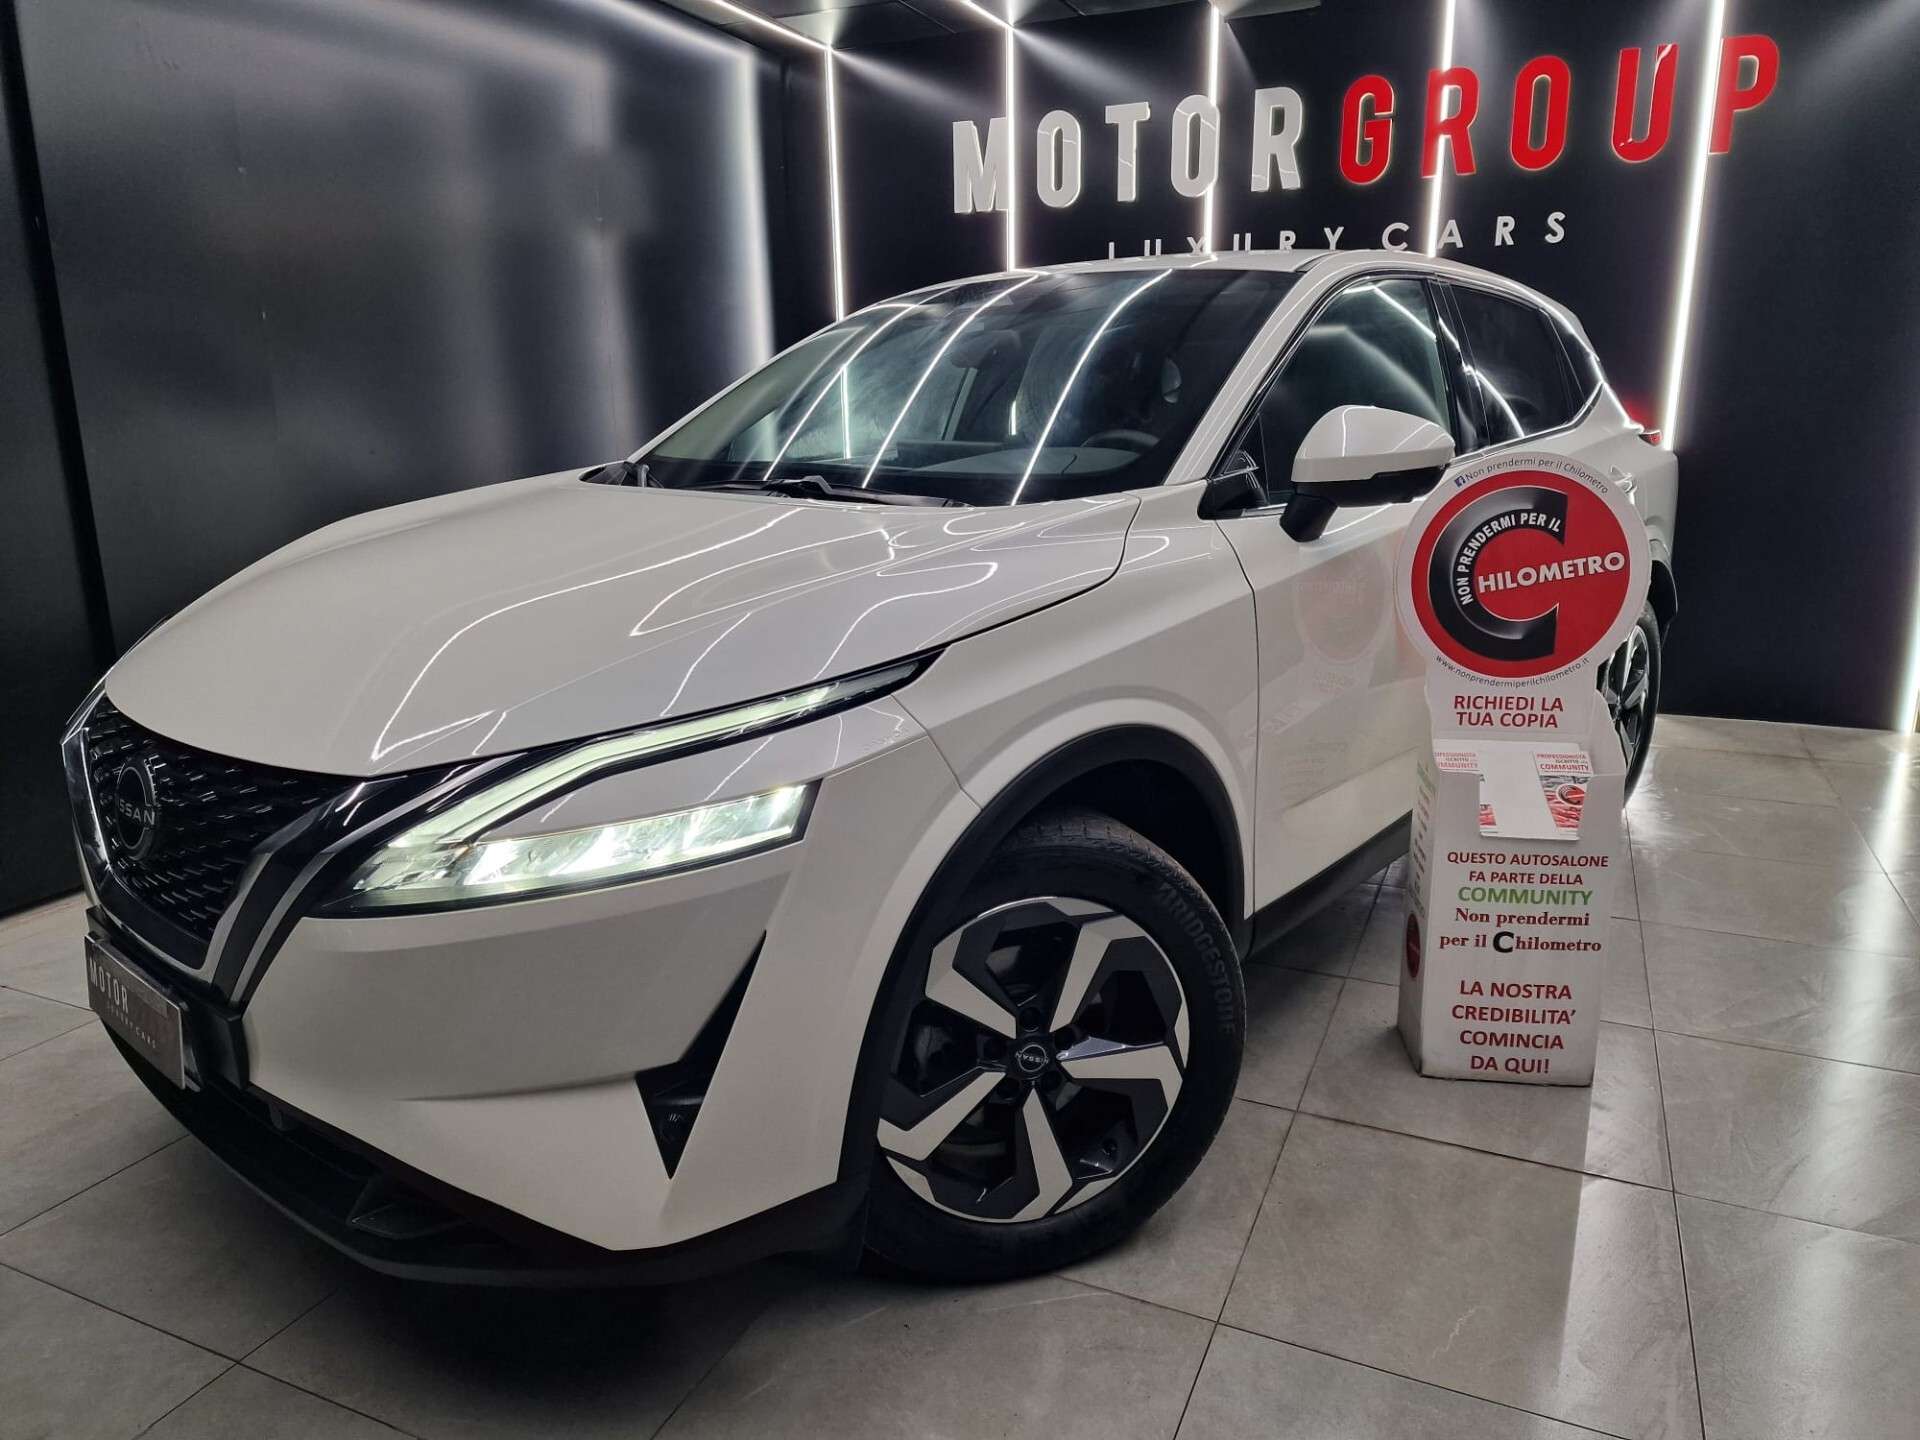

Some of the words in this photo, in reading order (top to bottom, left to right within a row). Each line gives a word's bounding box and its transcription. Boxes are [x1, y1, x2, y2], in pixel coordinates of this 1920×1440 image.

[1382, 212, 1566, 252] CARS
[1465, 469, 1485, 481] Non
[1487, 458, 1536, 473] prendermi
[1538, 458, 1554, 467] per
[1556, 459, 1563, 470] il
[1564, 463, 1609, 494] Chilometro
[1520, 512, 1547, 527] PER
[1548, 517, 1562, 533] IL
[1457, 514, 1516, 573] PRENDERMI
[1456, 577, 1474, 606] NON
[1436, 655, 1590, 689] www.nonprendermiperilchilometro.it
[1454, 695, 1535, 711] RICHIEDI
[1541, 697, 1564, 712] LA
[1456, 711, 1494, 727] TUA
[1500, 712, 1559, 728] COPIA
[1540, 763, 1589, 771] COMMUNITY
[1447, 851, 1506, 865] QUESTO
[1510, 853, 1609, 868] AUTOSALONE
[1468, 870, 1486, 882] FA
[1490, 871, 1535, 884] PARTE
[1539, 873, 1584, 885] DELLA
[1458, 886, 1593, 906] COMMUNITY
[1455, 907, 1490, 923] Non
[1496, 911, 1590, 928] prendermi
[1439, 935, 1469, 949] per
[1475, 934, 1487, 947] il
[1492, 931, 1602, 953] Chilometro
[89, 957, 129, 1014] MOTOR
[1460, 980, 1484, 996] LA
[1490, 982, 1572, 1000] NOSTRA
[1452, 1004, 1576, 1025] CREDIBILITA'
[1460, 1030, 1564, 1049] COMINCIA
[1470, 1055, 1498, 1071] DA
[1504, 1057, 1550, 1074] QUI!
